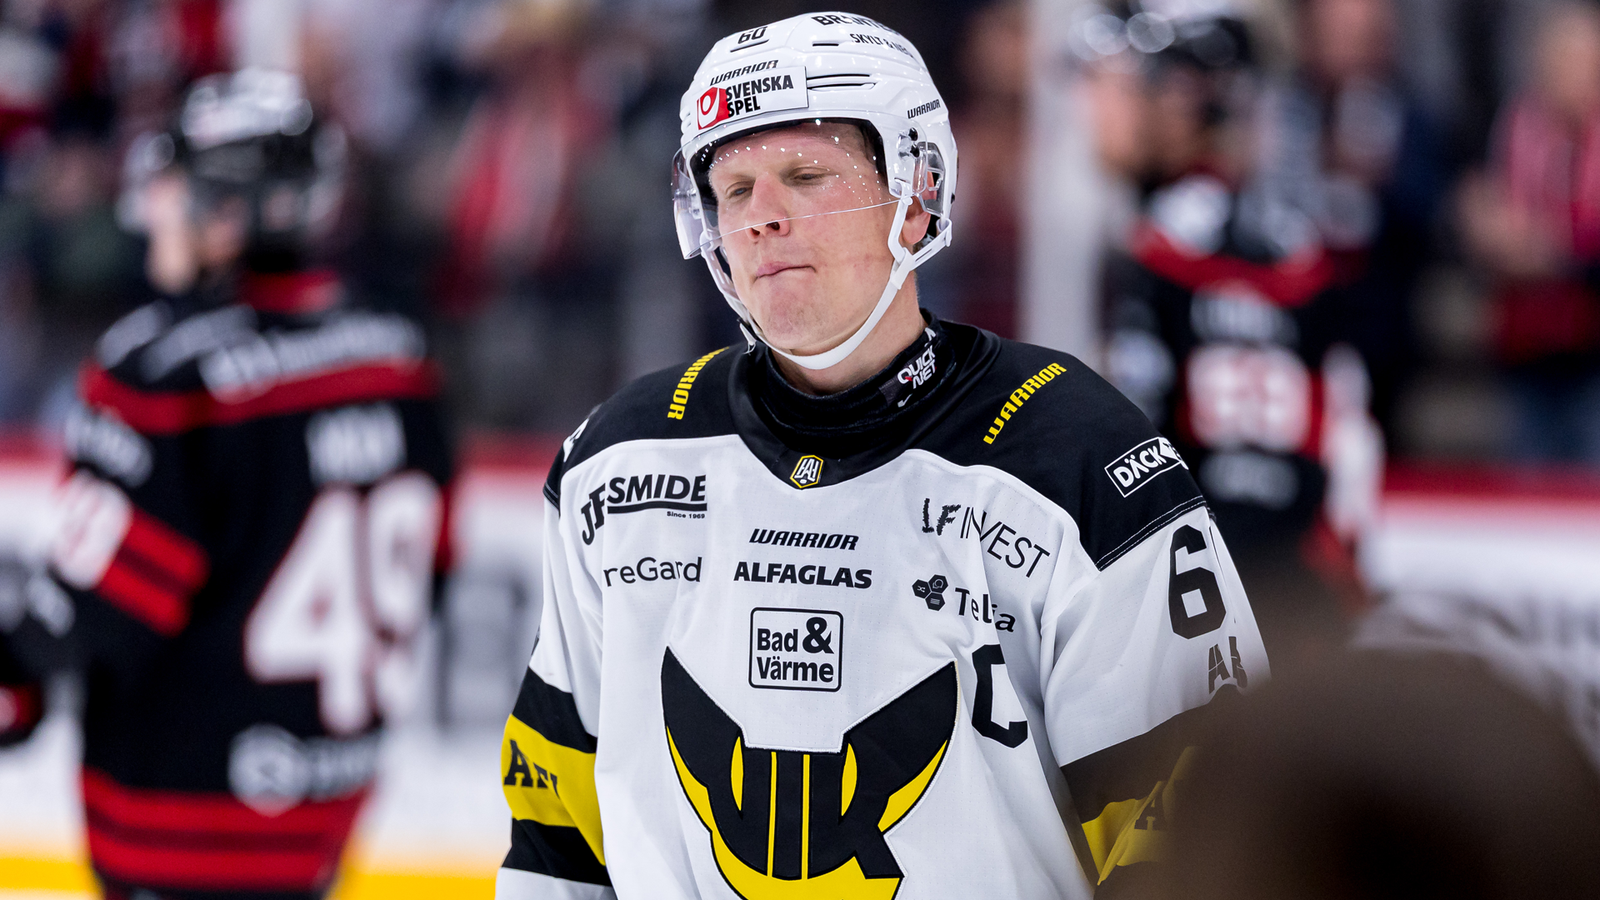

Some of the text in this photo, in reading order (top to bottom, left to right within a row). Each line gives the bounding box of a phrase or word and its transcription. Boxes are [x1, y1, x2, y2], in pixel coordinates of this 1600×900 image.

[738, 26, 768, 44] 60
[850, 33, 883, 46] SKYLT
[710, 60, 778, 86] WARRIOR
[726, 75, 793, 102] SVENSKA
[727, 96, 761, 117] SPEL
[907, 99, 941, 119] WARRIOR
[897, 345, 936, 384] QUICK
[913, 359, 937, 389] NET
[983, 362, 1067, 445] WARRIOR
[1113, 446, 1167, 487] DÄCK
[666, 511, 686, 519] Since
[749, 528, 859, 551] WARRIOR
[733, 561, 873, 589] ALFAGLAS
[1167, 524, 1237, 640] 6
[757, 617, 835, 654] Bad &
[756, 655, 835, 683] Värme
[972, 643, 1028, 749] C
